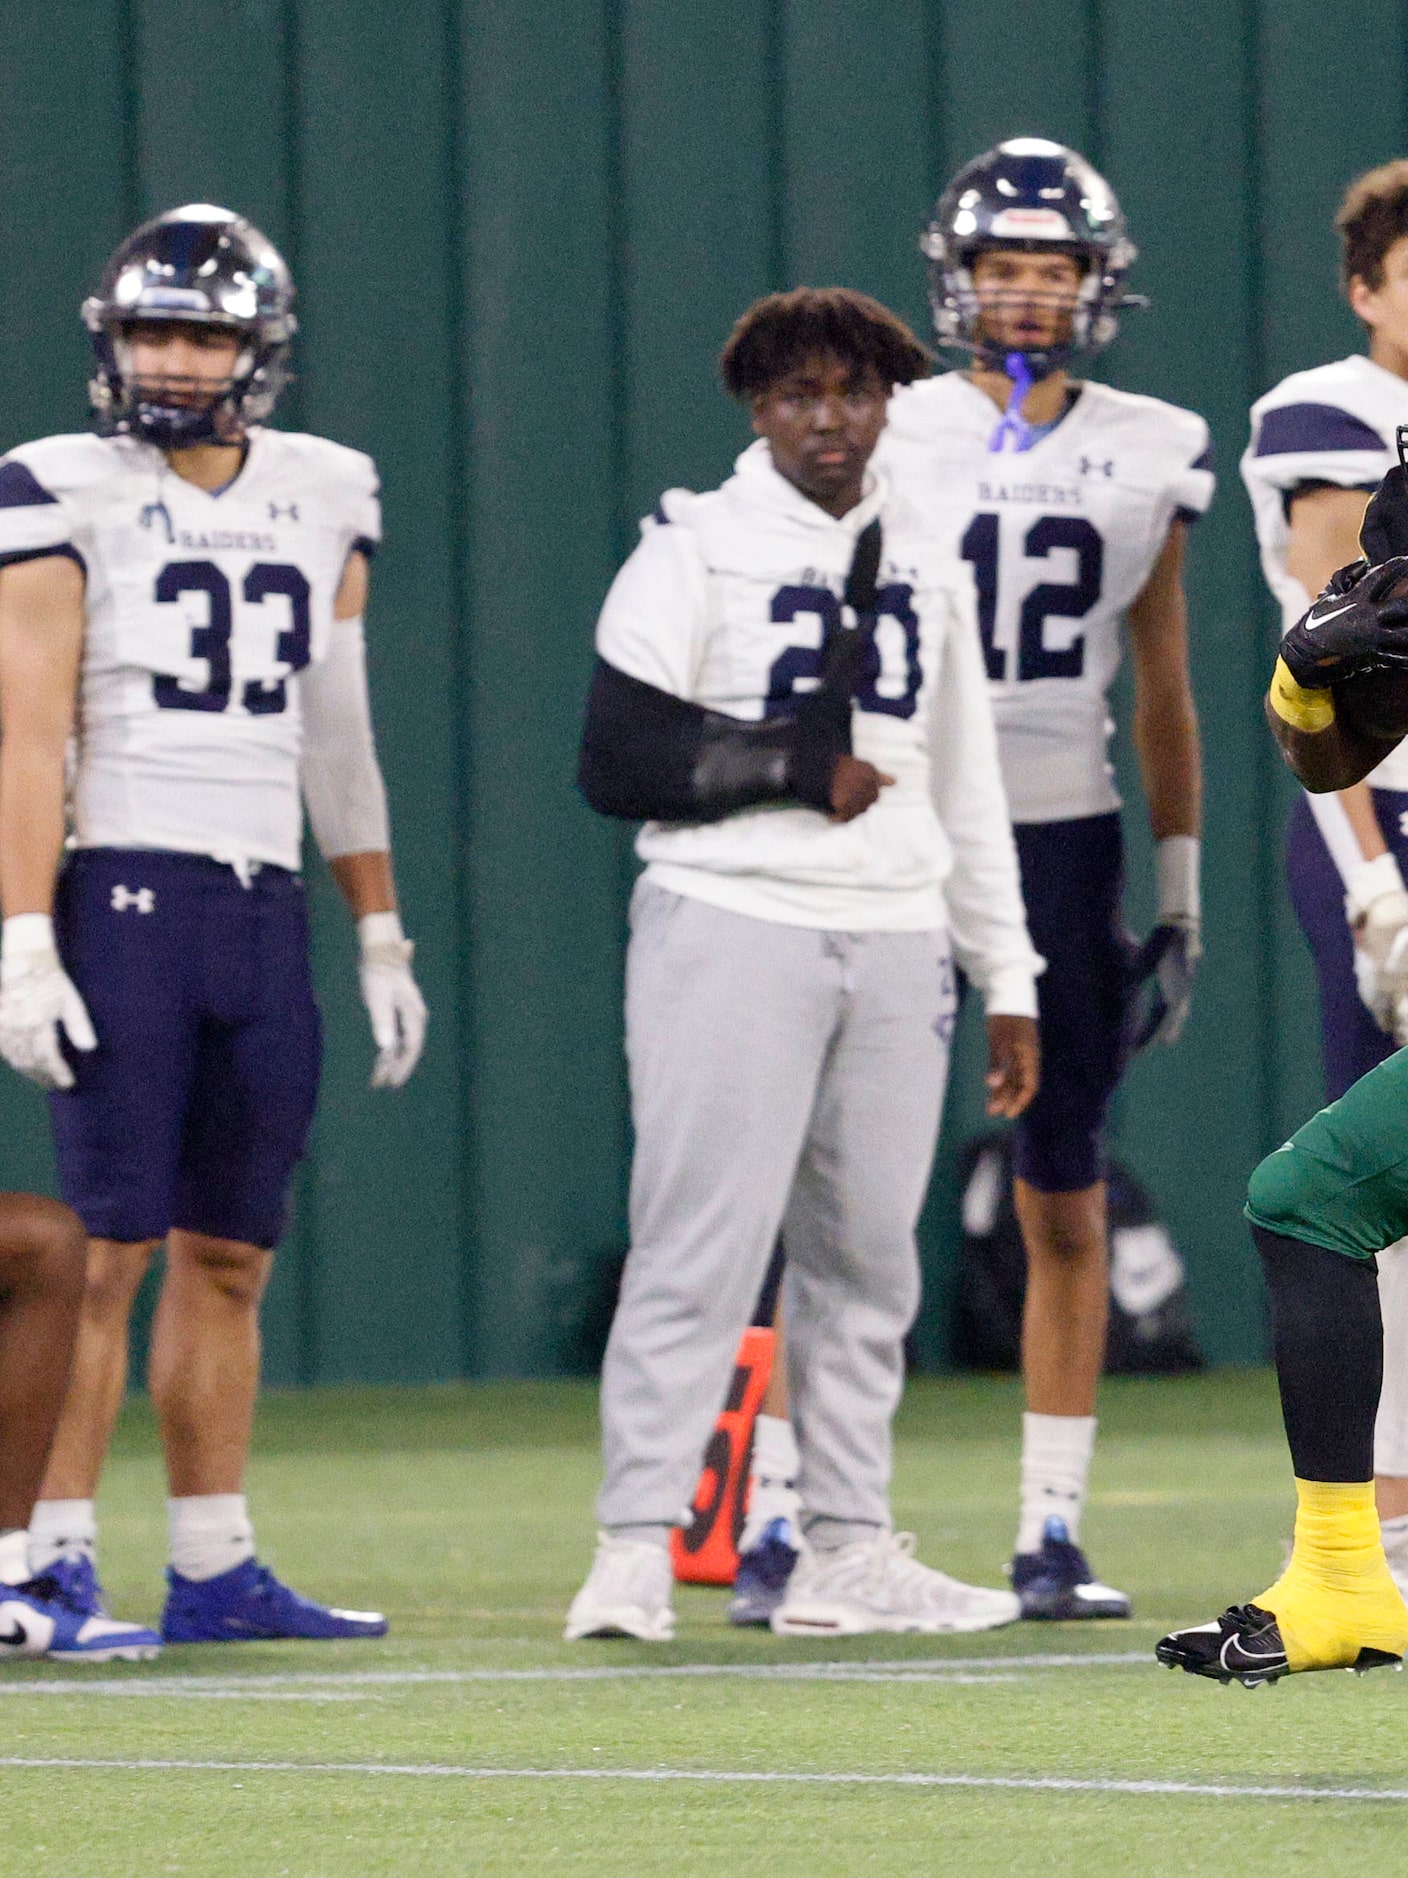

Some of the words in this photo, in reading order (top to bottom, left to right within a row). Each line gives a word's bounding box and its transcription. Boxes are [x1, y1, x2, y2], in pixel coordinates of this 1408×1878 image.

[180, 532, 277, 552] RAIDERS
[977, 482, 1082, 502] RAIDERS
[152, 560, 312, 716] 33
[764, 583, 924, 721] 20
[959, 512, 1105, 682] 12
